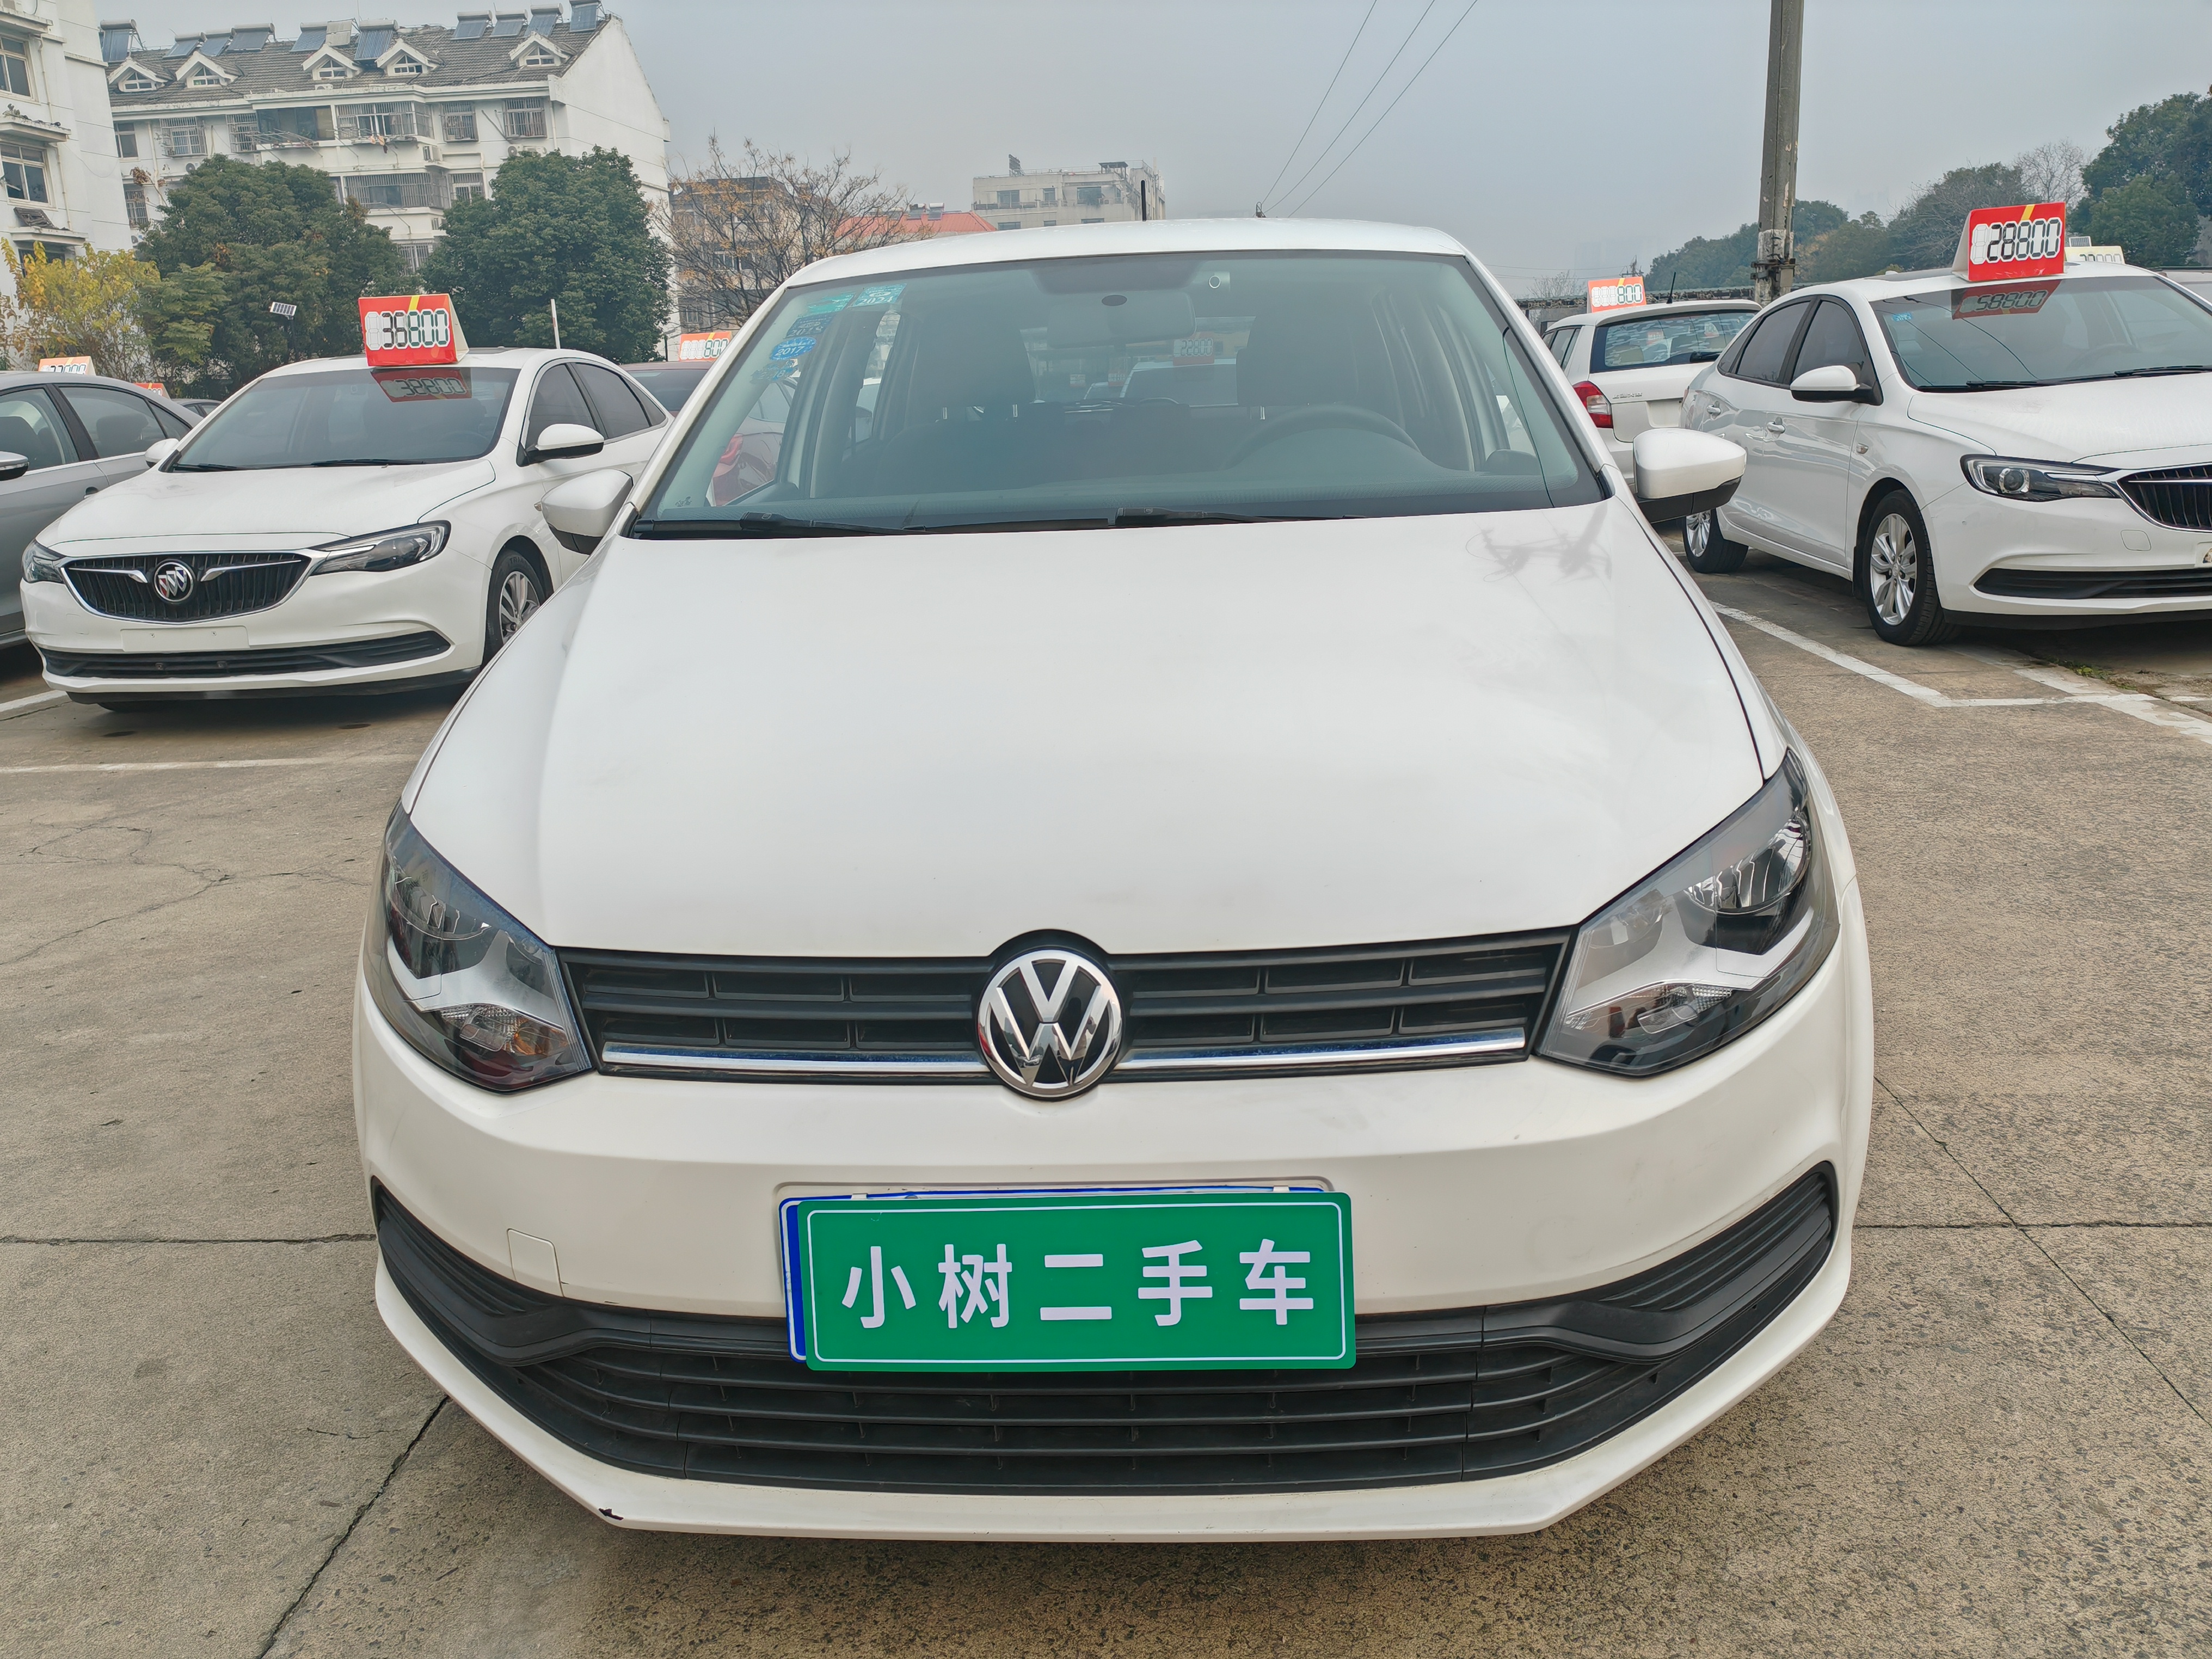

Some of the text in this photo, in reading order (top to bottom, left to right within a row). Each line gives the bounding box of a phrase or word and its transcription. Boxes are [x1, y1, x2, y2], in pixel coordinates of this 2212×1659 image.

[1987, 219, 2060, 261] 28800
[382, 310, 448, 348] 36800
[774, 346, 805, 356] 2017
[841, 1238, 1314, 1329] 小树二手车
